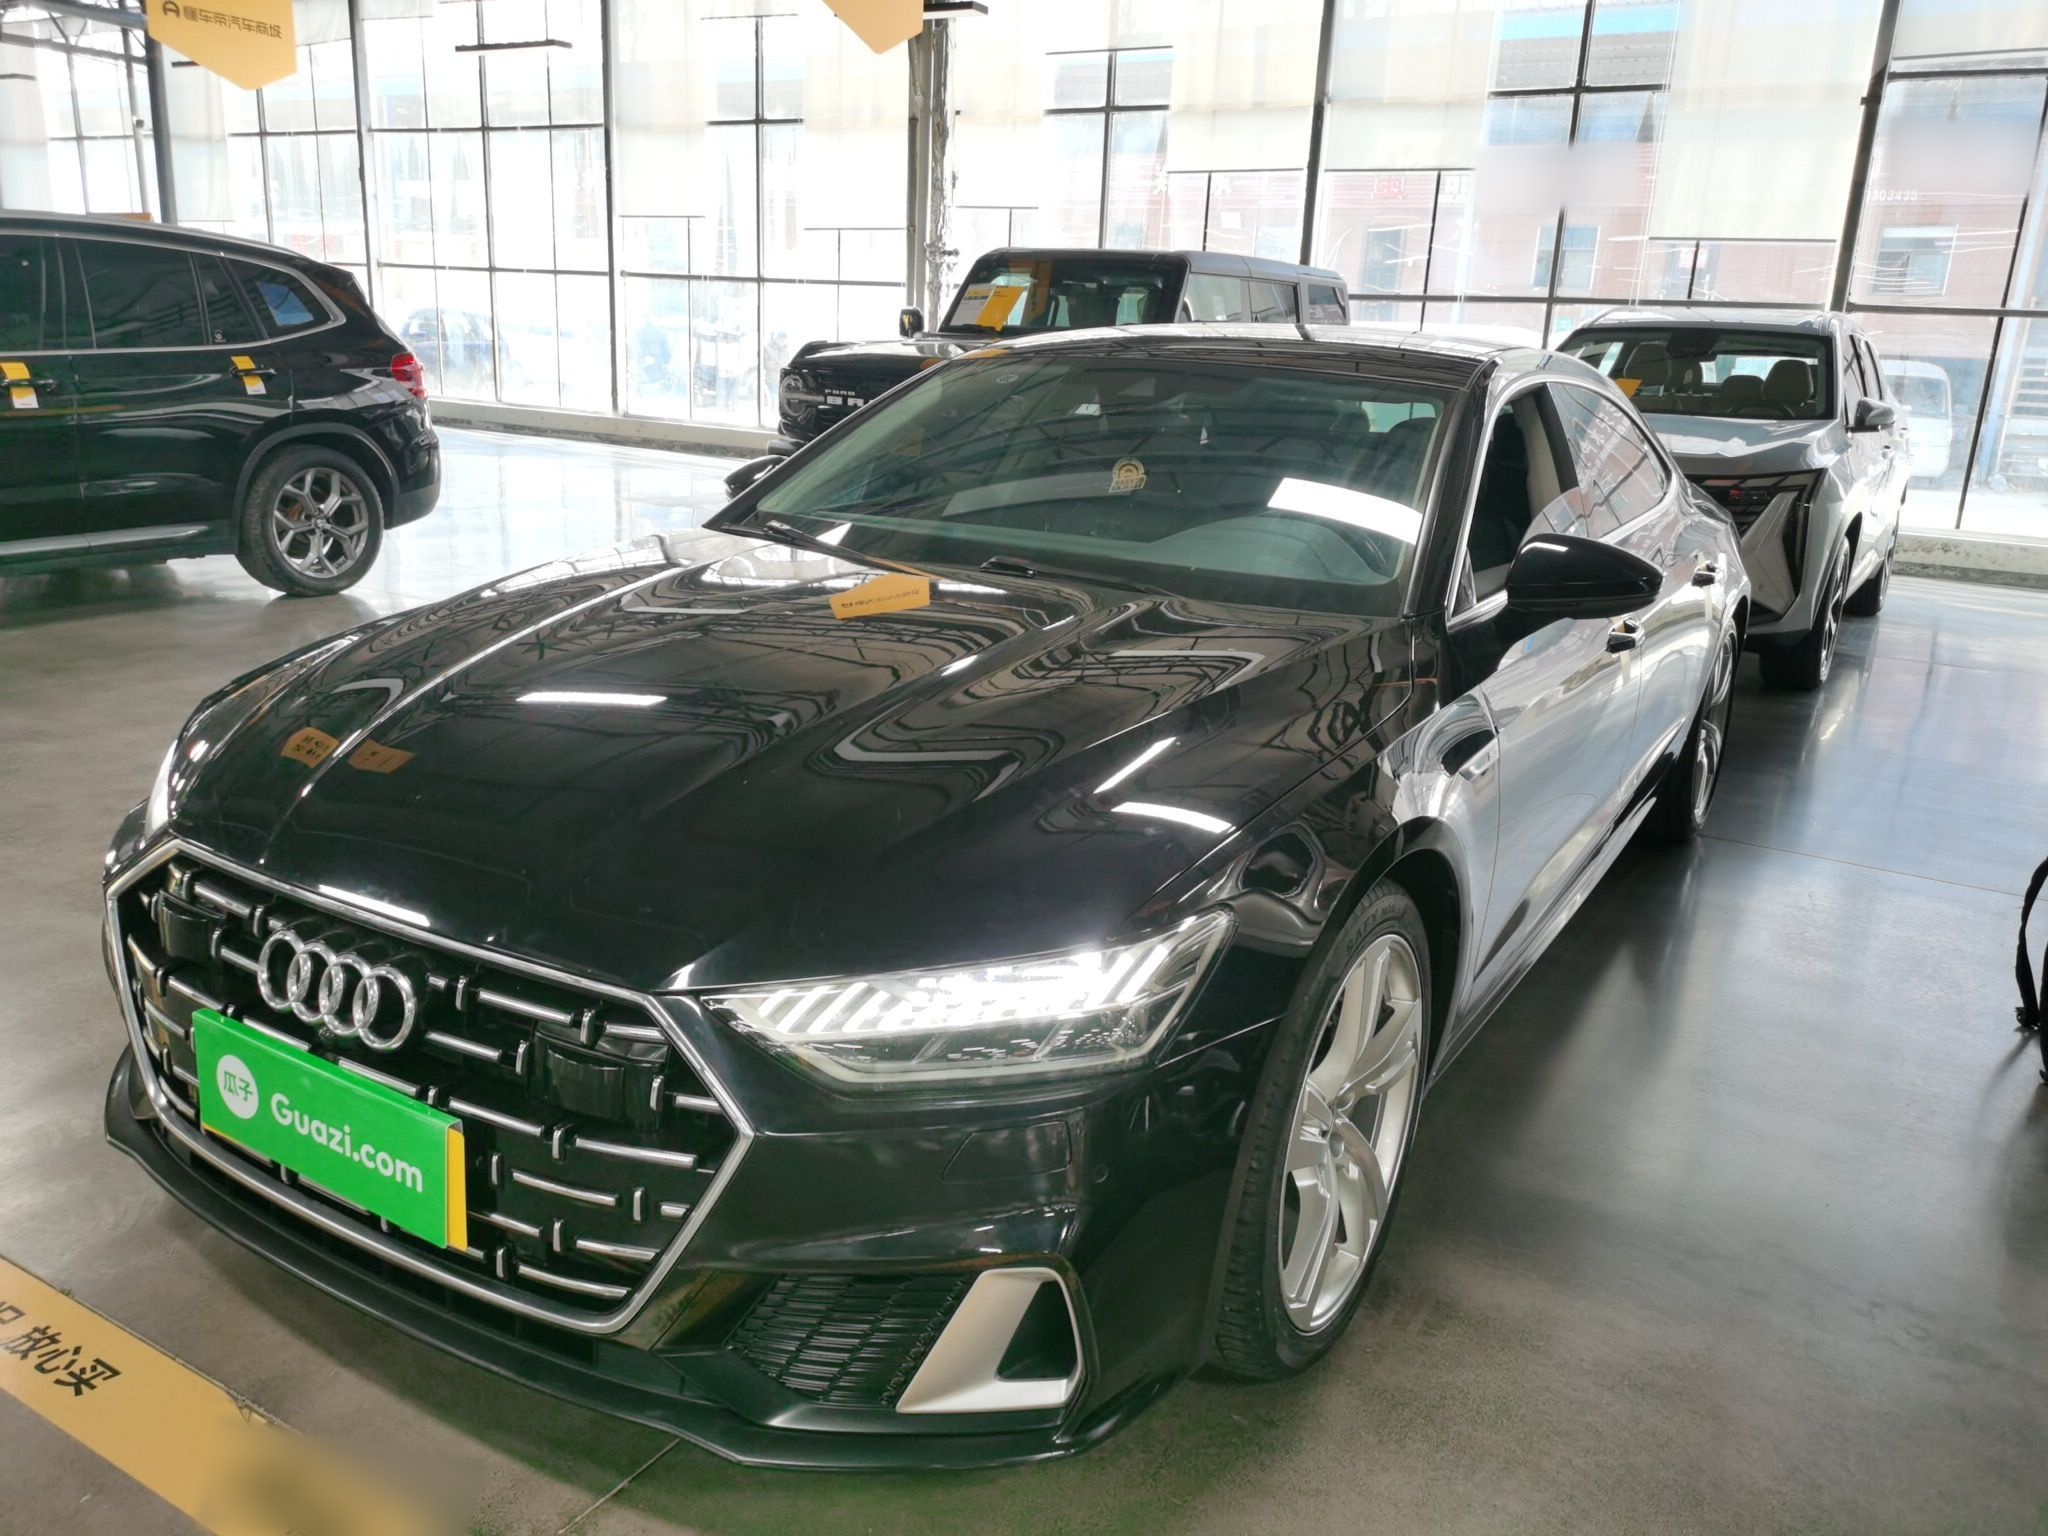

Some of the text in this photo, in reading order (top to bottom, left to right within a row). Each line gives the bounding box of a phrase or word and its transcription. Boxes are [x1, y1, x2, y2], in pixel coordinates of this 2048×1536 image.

[223, 1071, 423, 1193] 瓜子 Guazi.com
[1, 1325, 122, 1396] 放心买
